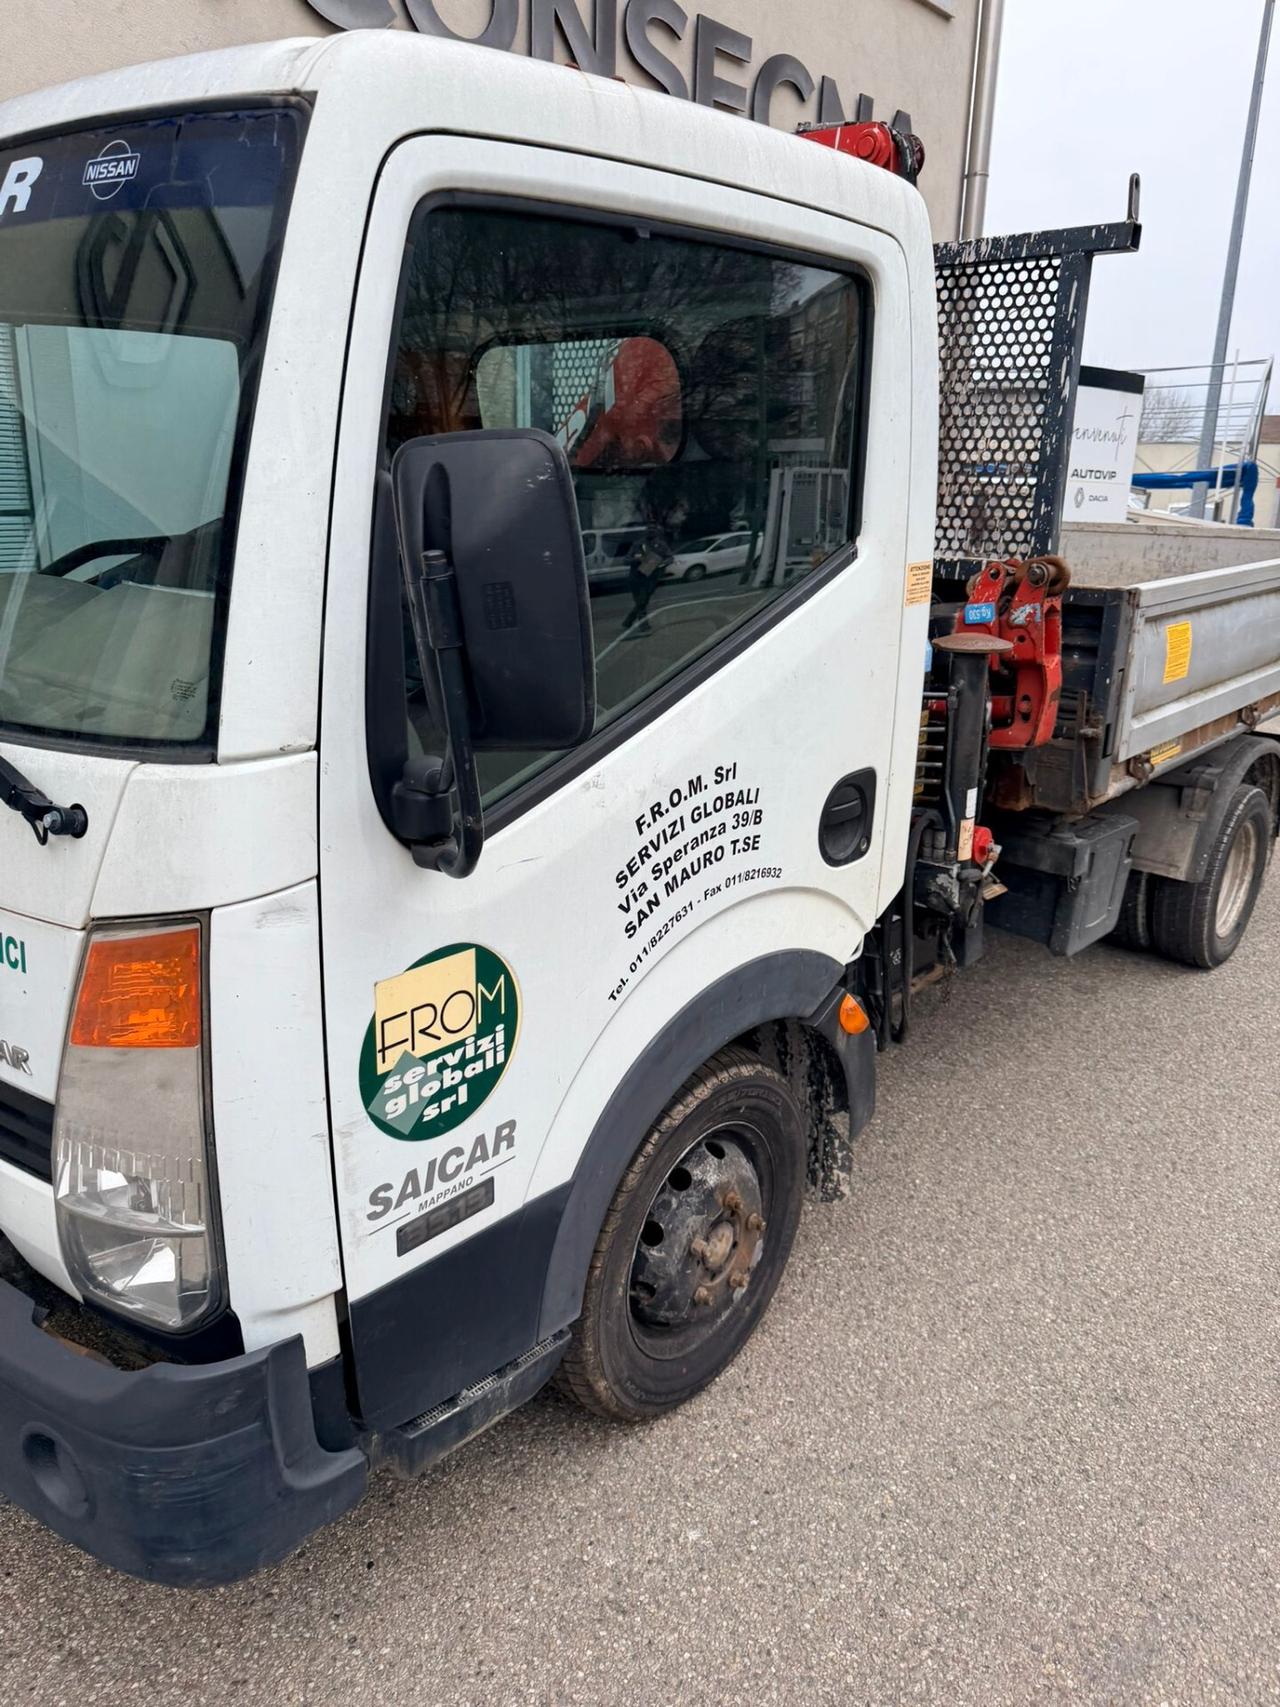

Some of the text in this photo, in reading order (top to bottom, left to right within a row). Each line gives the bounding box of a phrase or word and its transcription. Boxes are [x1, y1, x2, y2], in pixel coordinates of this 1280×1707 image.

[86, 159, 136, 180] NISSAN
[1070, 468, 1117, 480] AUTOVIP
[1088, 494, 1109, 502] DACIA
[635, 762, 737, 836] F.R.O.M. Srl
[615, 788, 760, 889] SERVIZI GLOBALI
[617, 809, 763, 915] Via Speranza 39/B
[624, 835, 761, 939] SAN MAURO T.SE
[608, 977, 629, 1002] Tel.
[629, 901, 694, 974] 011/8227631
[704, 883, 722, 901] Fax
[725, 868, 783, 889] 011/8216932
[377, 974, 505, 1064] FROM
[383, 1023, 505, 1096] servizi
[384, 1044, 505, 1120] globali
[421, 1083, 469, 1123] srl
[366, 1118, 518, 1221] SAICAR
[418, 1175, 474, 1213] MAPPANO
